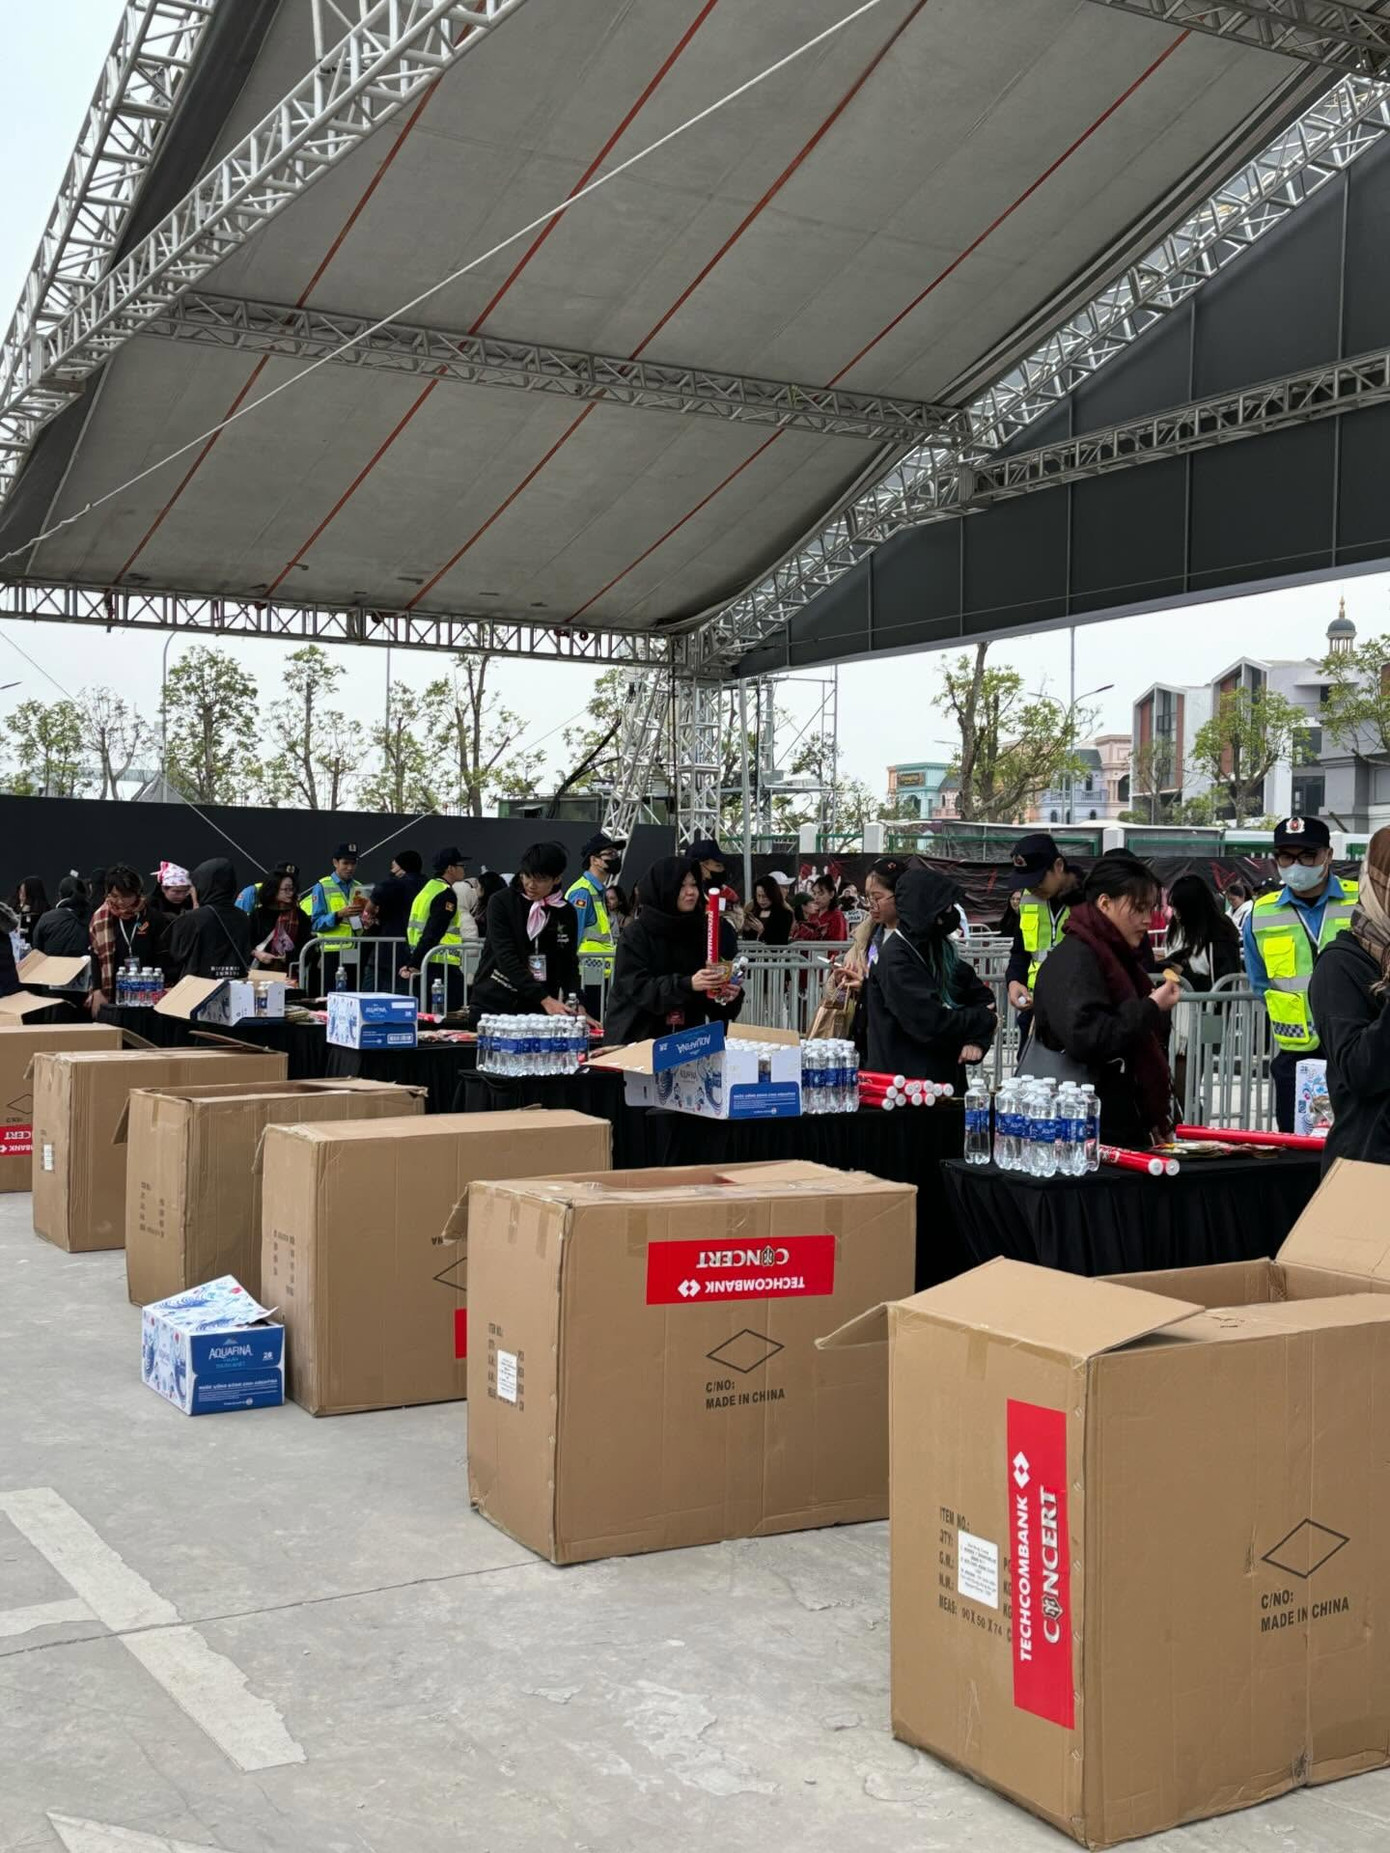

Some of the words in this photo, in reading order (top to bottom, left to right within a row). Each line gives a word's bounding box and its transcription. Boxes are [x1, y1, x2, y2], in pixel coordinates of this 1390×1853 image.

[4, 1131, 32, 1140] CERT
[695, 1244, 790, 1269] CONCERT
[704, 1276, 806, 1294] TECHCOMBANK
[208, 1344, 254, 1360] AQUAFINA
[705, 1379, 735, 1394] C/NO:
[705, 1395, 736, 1410] MADE
[739, 1392, 750, 1405] IN
[752, 1388, 785, 1404] CHINA
[939, 1506, 955, 1526] ITEM
[1040, 1484, 1063, 1644] CONCERT
[1016, 1493, 1032, 1662] TECHCOMBANK
[1261, 1590, 1294, 1610] C/NO:
[1261, 1611, 1295, 1633] MADE
[1298, 1606, 1309, 1623] IN
[1311, 1597, 1350, 1619] CHINA
